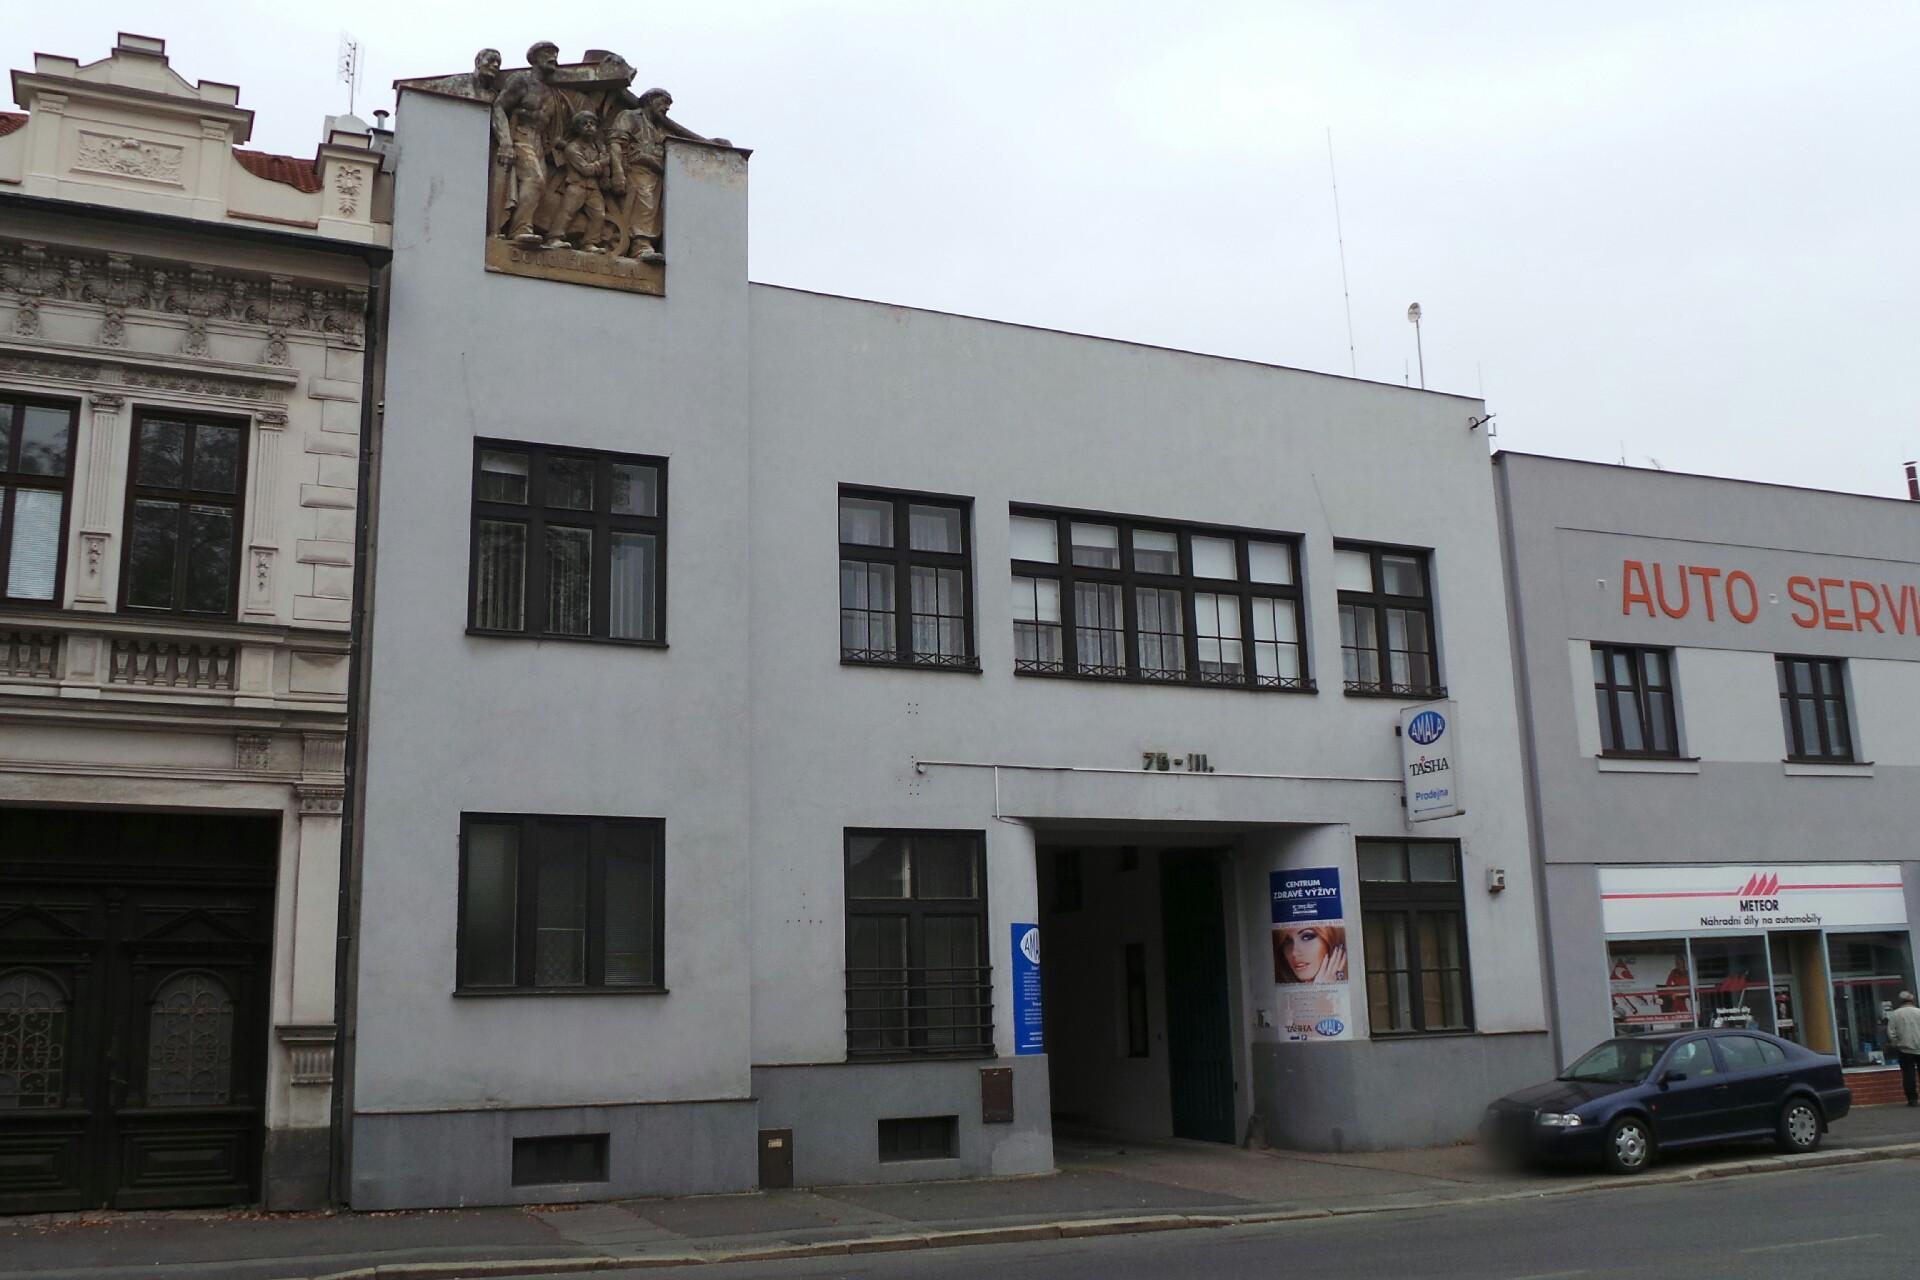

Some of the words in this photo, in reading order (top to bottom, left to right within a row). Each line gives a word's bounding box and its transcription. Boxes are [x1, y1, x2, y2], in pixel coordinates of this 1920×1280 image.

[1622, 560, 1759, 624] AUTO
[1787, 576, 1920, 637] SERVI
[1411, 713, 1443, 743] AMALA
[1410, 757, 1449, 776] TASHA
[1416, 788, 1448, 801] Prodejna
[1286, 880, 1320, 888] CENTRUM
[1305, 886, 1336, 896] VÝŽIVY
[1740, 900, 1779, 911] METEOR
[1700, 915, 1741, 926] Náhradní
[1744, 914, 1759, 927] díly
[1775, 913, 1822, 925] automobily
